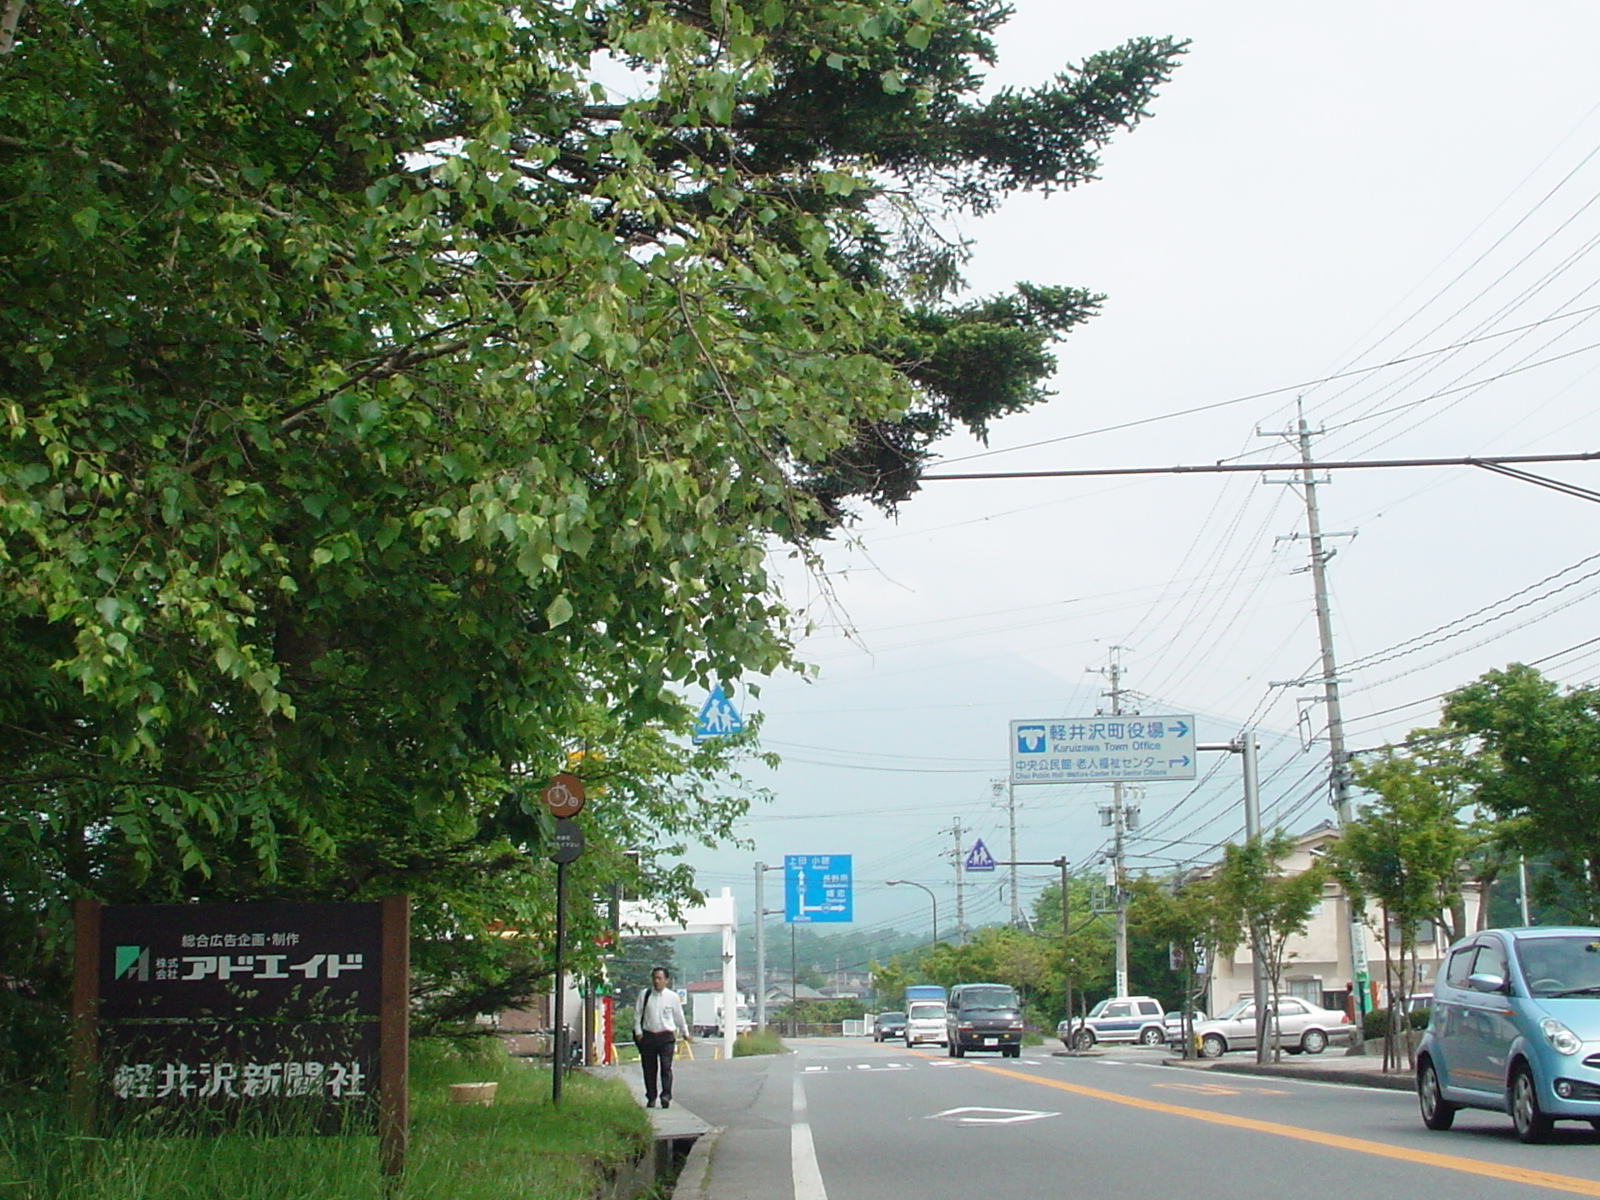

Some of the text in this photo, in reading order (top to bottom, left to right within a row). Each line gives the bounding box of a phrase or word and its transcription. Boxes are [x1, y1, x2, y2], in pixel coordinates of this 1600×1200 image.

[1049, 722, 1164, 741] 軽井沢町役場
[1053, 741, 1161, 753] Karuizawa Town Office
[182, 932, 299, 948] 総合広告企画・制作
[181, 954, 363, 980] アドエイド
[114, 1060, 365, 1099] 軽井沢新聞社
